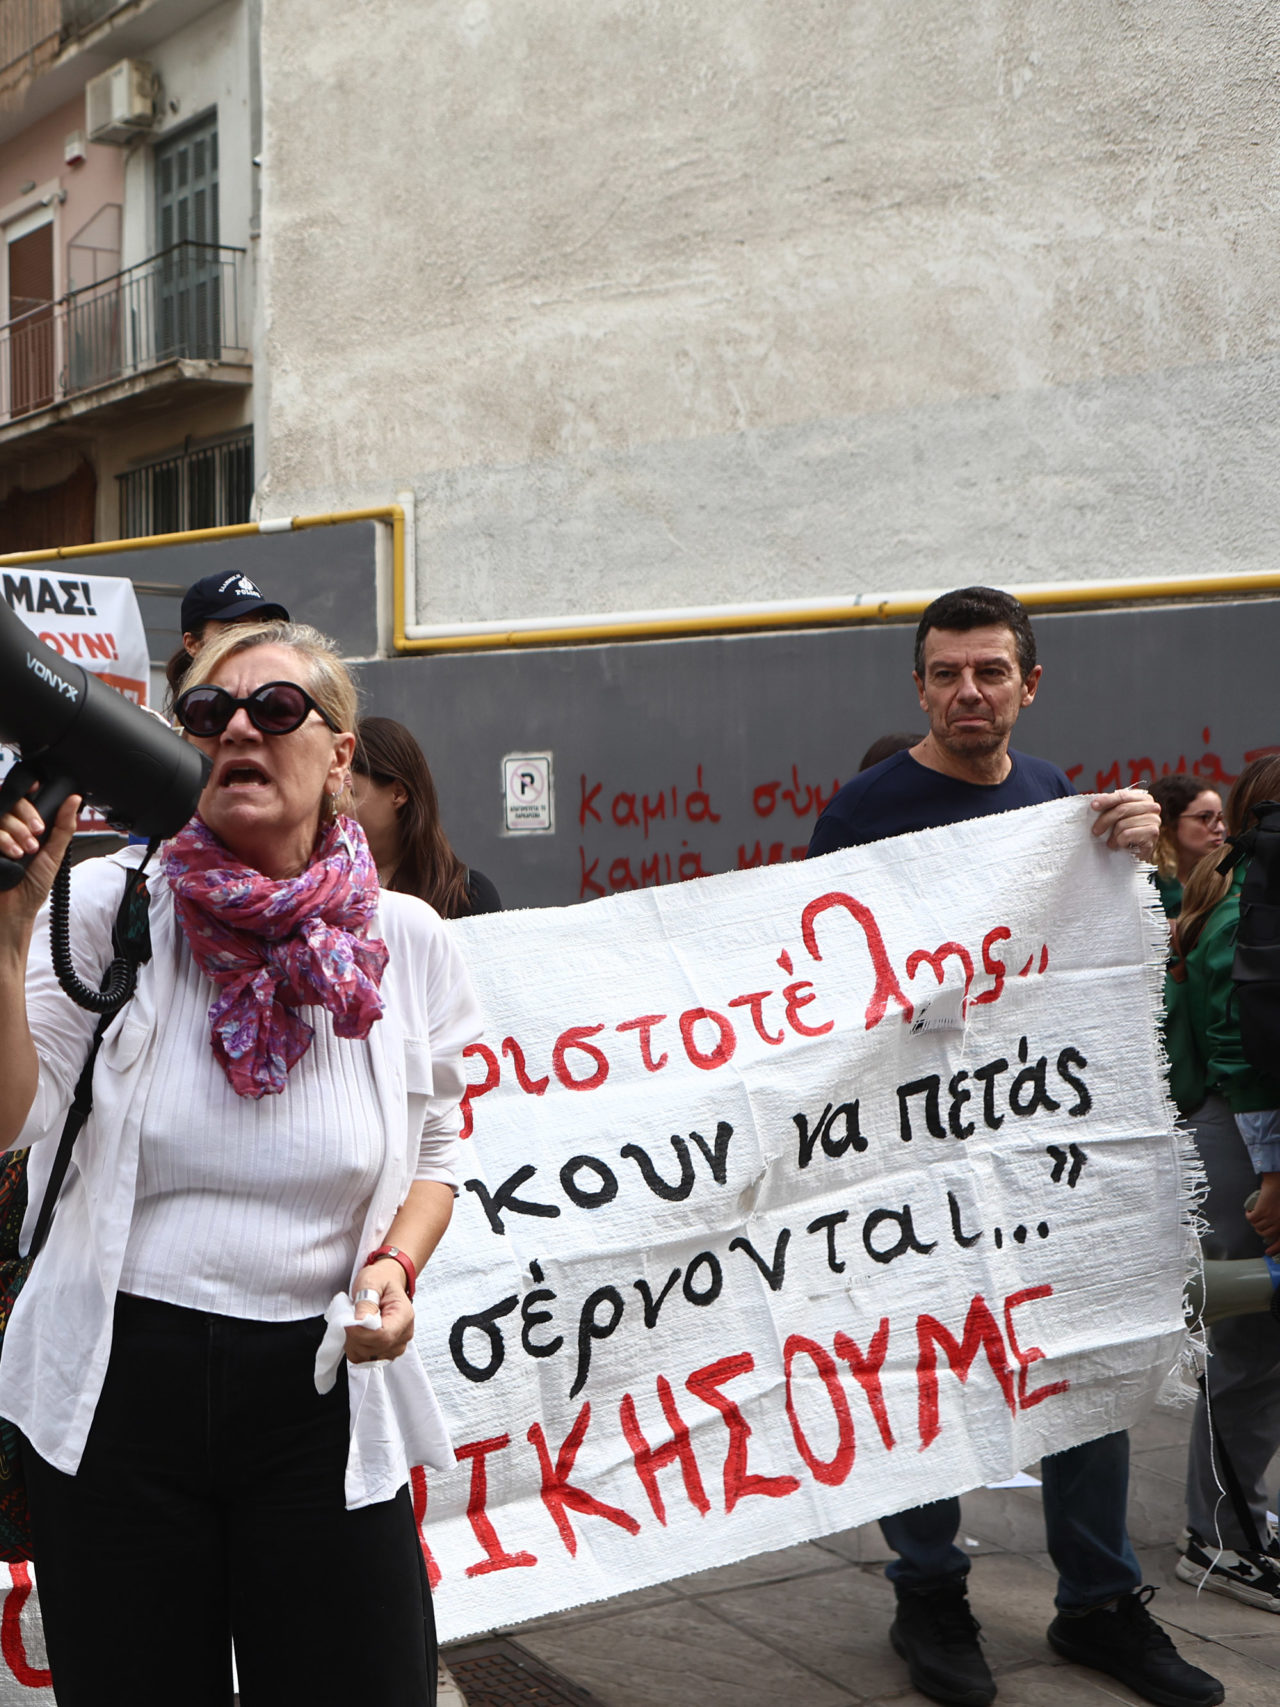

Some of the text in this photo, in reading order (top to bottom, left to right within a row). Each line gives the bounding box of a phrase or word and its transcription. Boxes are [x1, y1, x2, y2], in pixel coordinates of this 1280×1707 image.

[2, 574, 97, 616] ΜΑΣ!
[38, 631, 118, 660] ΟΥΝ!
[26, 652, 79, 703] VONYX
[463, 1122, 734, 1235] κουν
[793, 1100, 867, 1169] να
[897, 1037, 1092, 1142] πετάς
